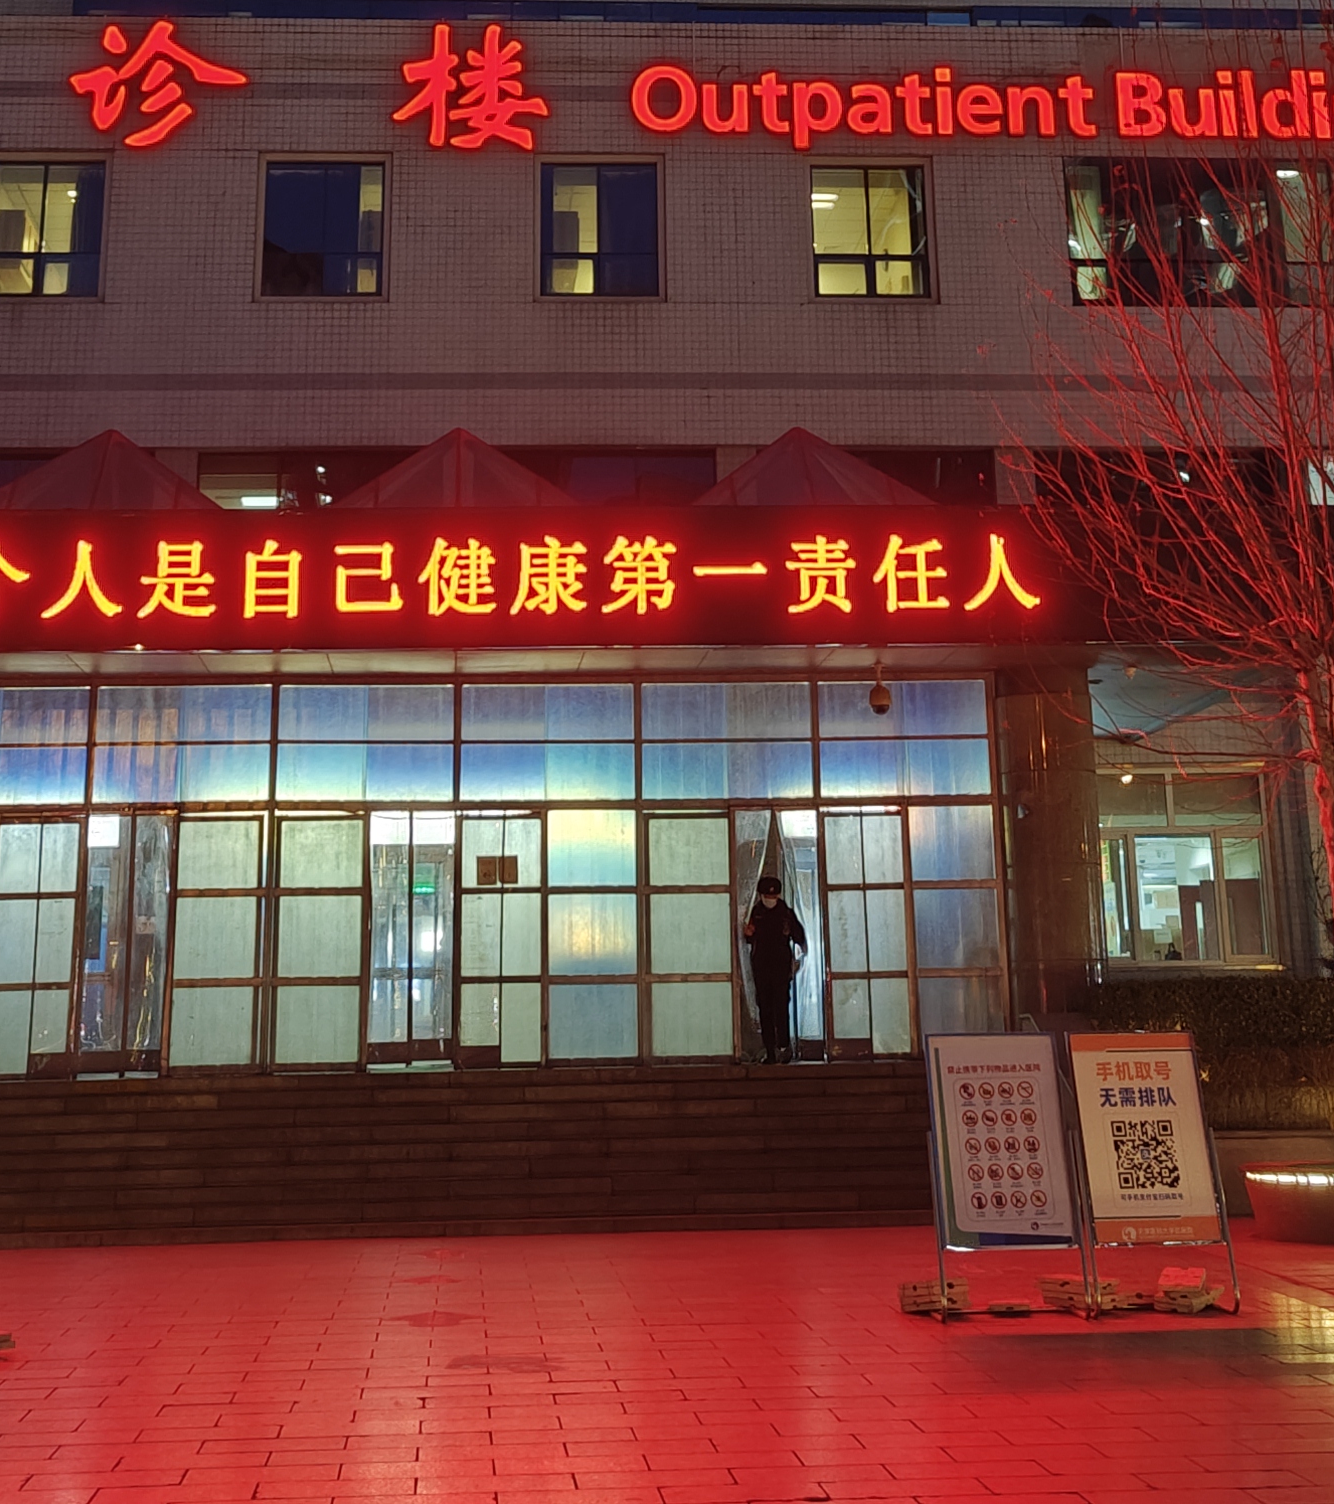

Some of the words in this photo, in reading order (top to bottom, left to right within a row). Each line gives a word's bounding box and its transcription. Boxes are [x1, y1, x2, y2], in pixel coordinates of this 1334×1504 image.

[630, 63, 1097, 151] Outpatient
[1095, 1061, 1173, 1082] 手机取号
[1099, 1086, 1178, 1108] 无需排队
